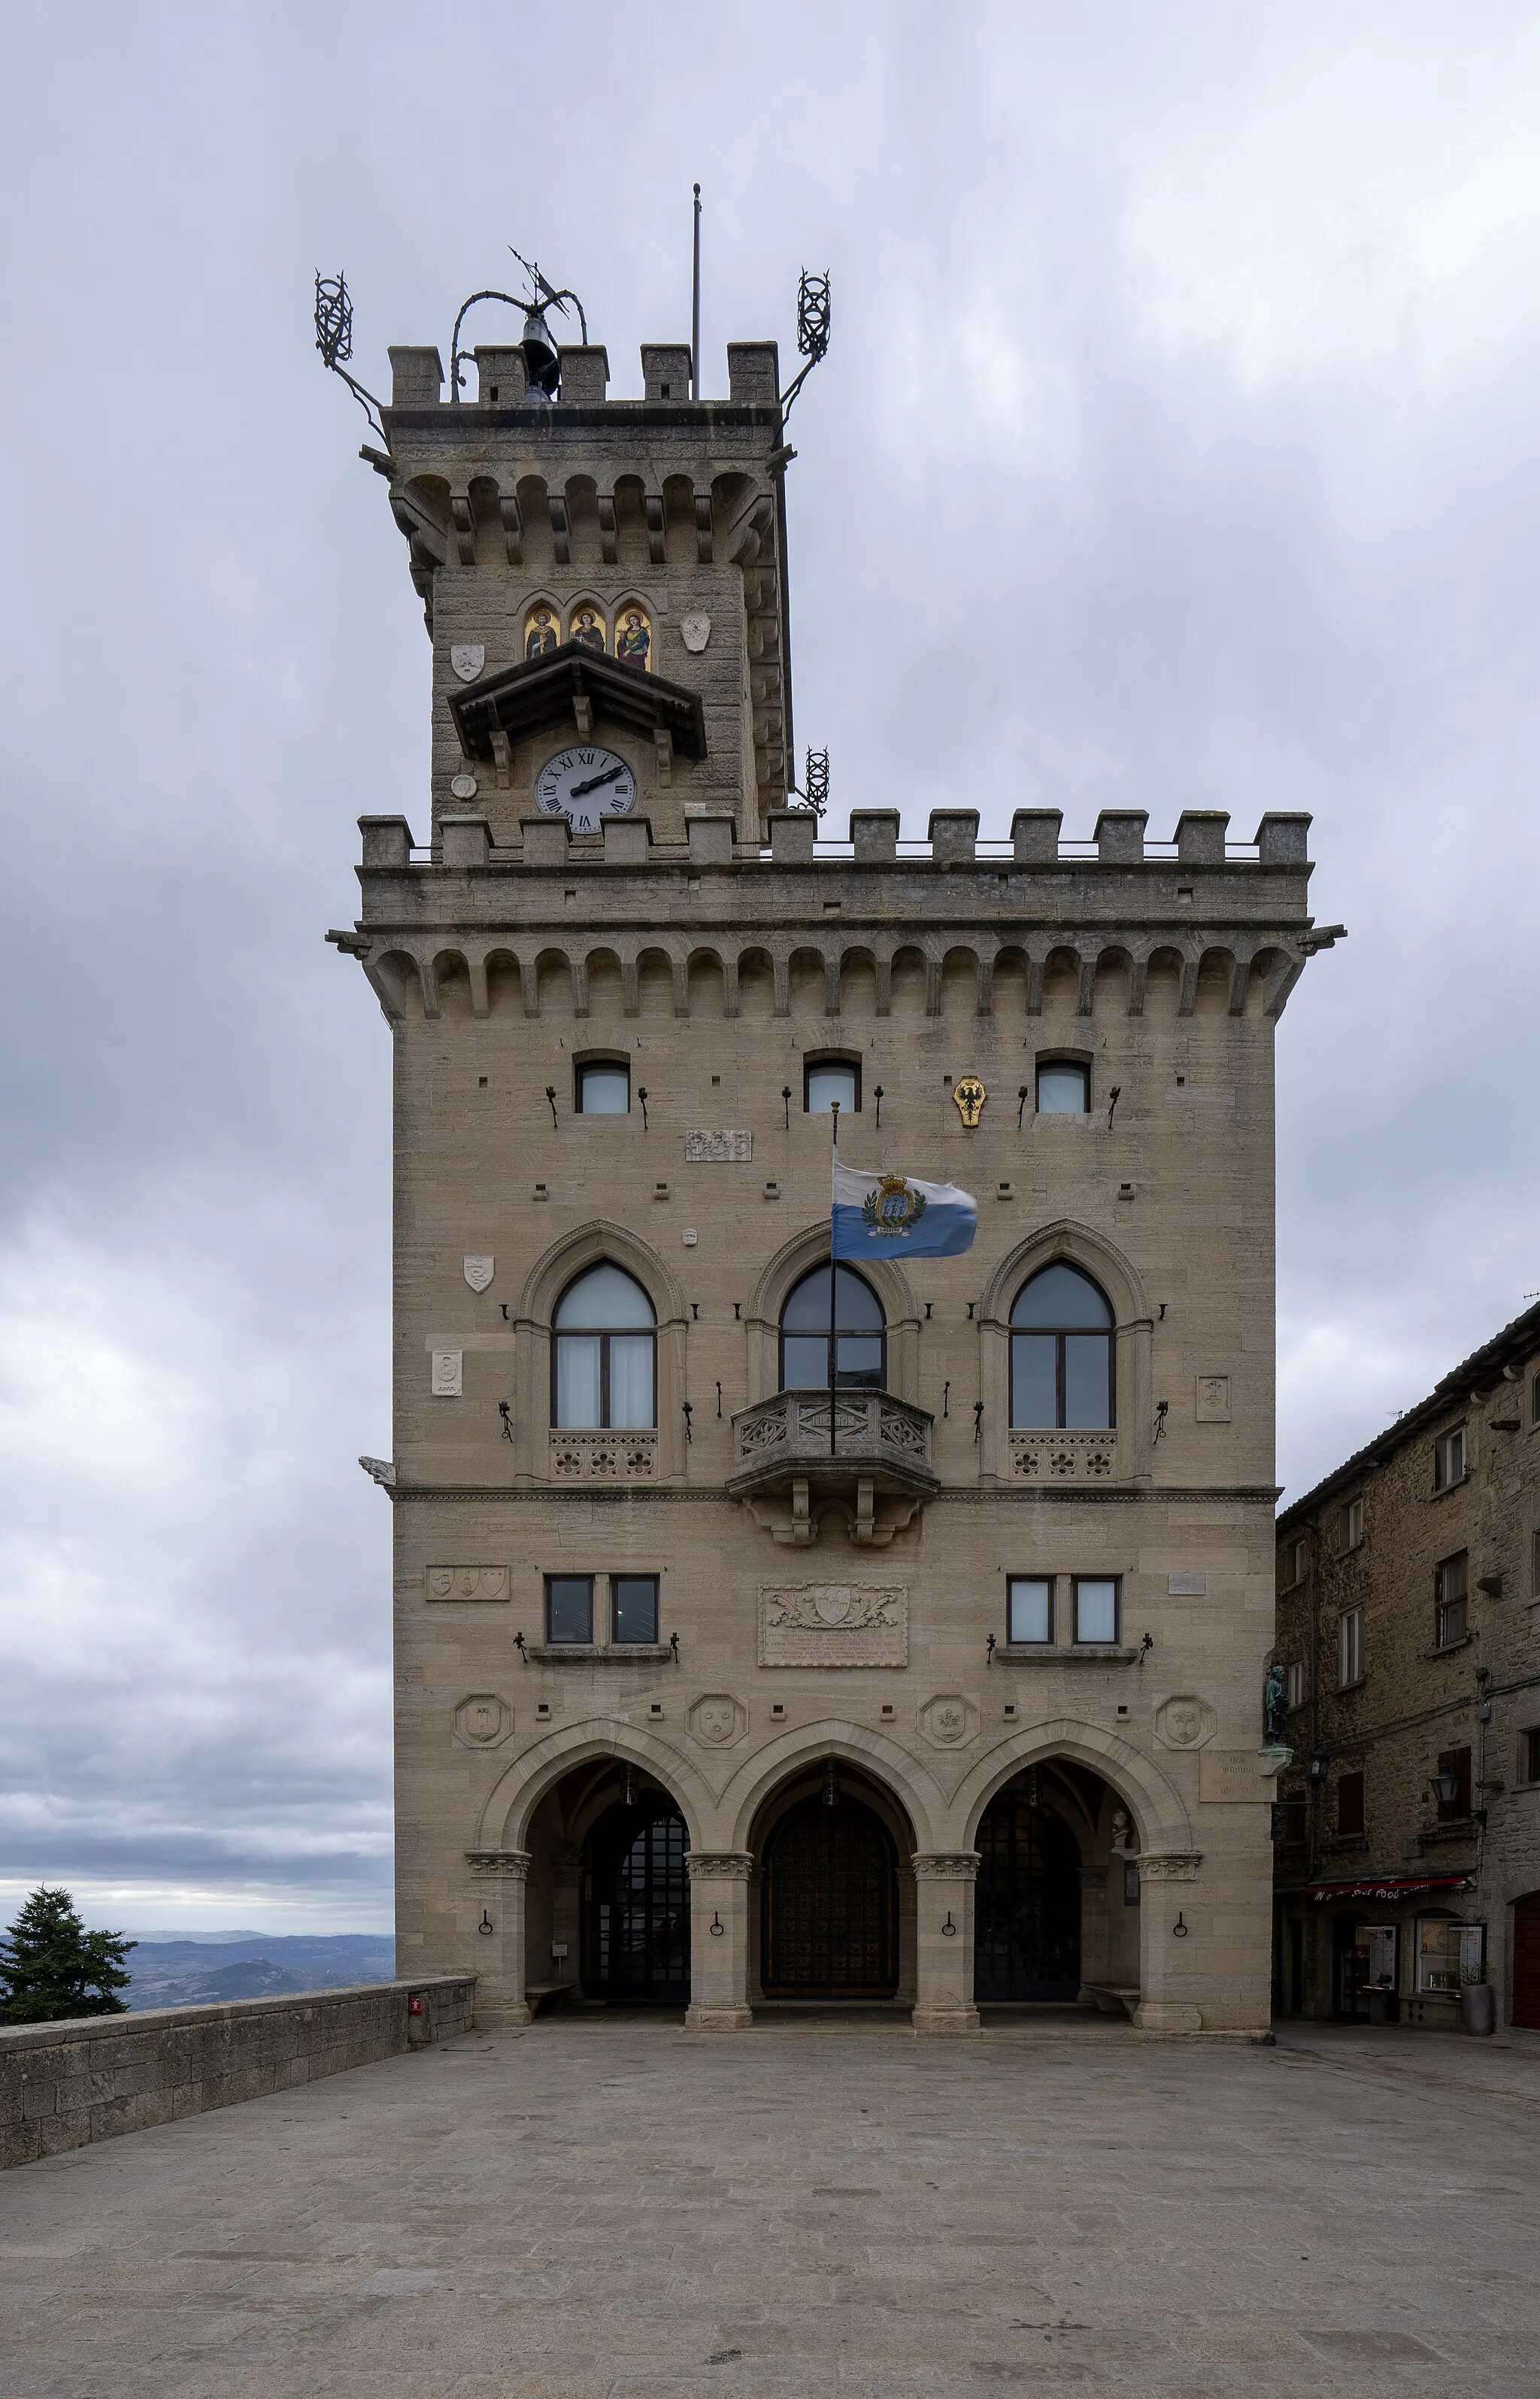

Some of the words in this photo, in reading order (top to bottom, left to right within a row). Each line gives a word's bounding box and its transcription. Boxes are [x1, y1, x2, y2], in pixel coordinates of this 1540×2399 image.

[559, 757, 574, 771] XI
[578, 753, 595, 765] XII
[600, 758, 608, 768] I
[548, 770, 562, 781] X
[544, 784, 556, 796] IX
[615, 785, 628, 795] III
[610, 799, 625, 812] IV
[579, 815, 591, 827] VI
